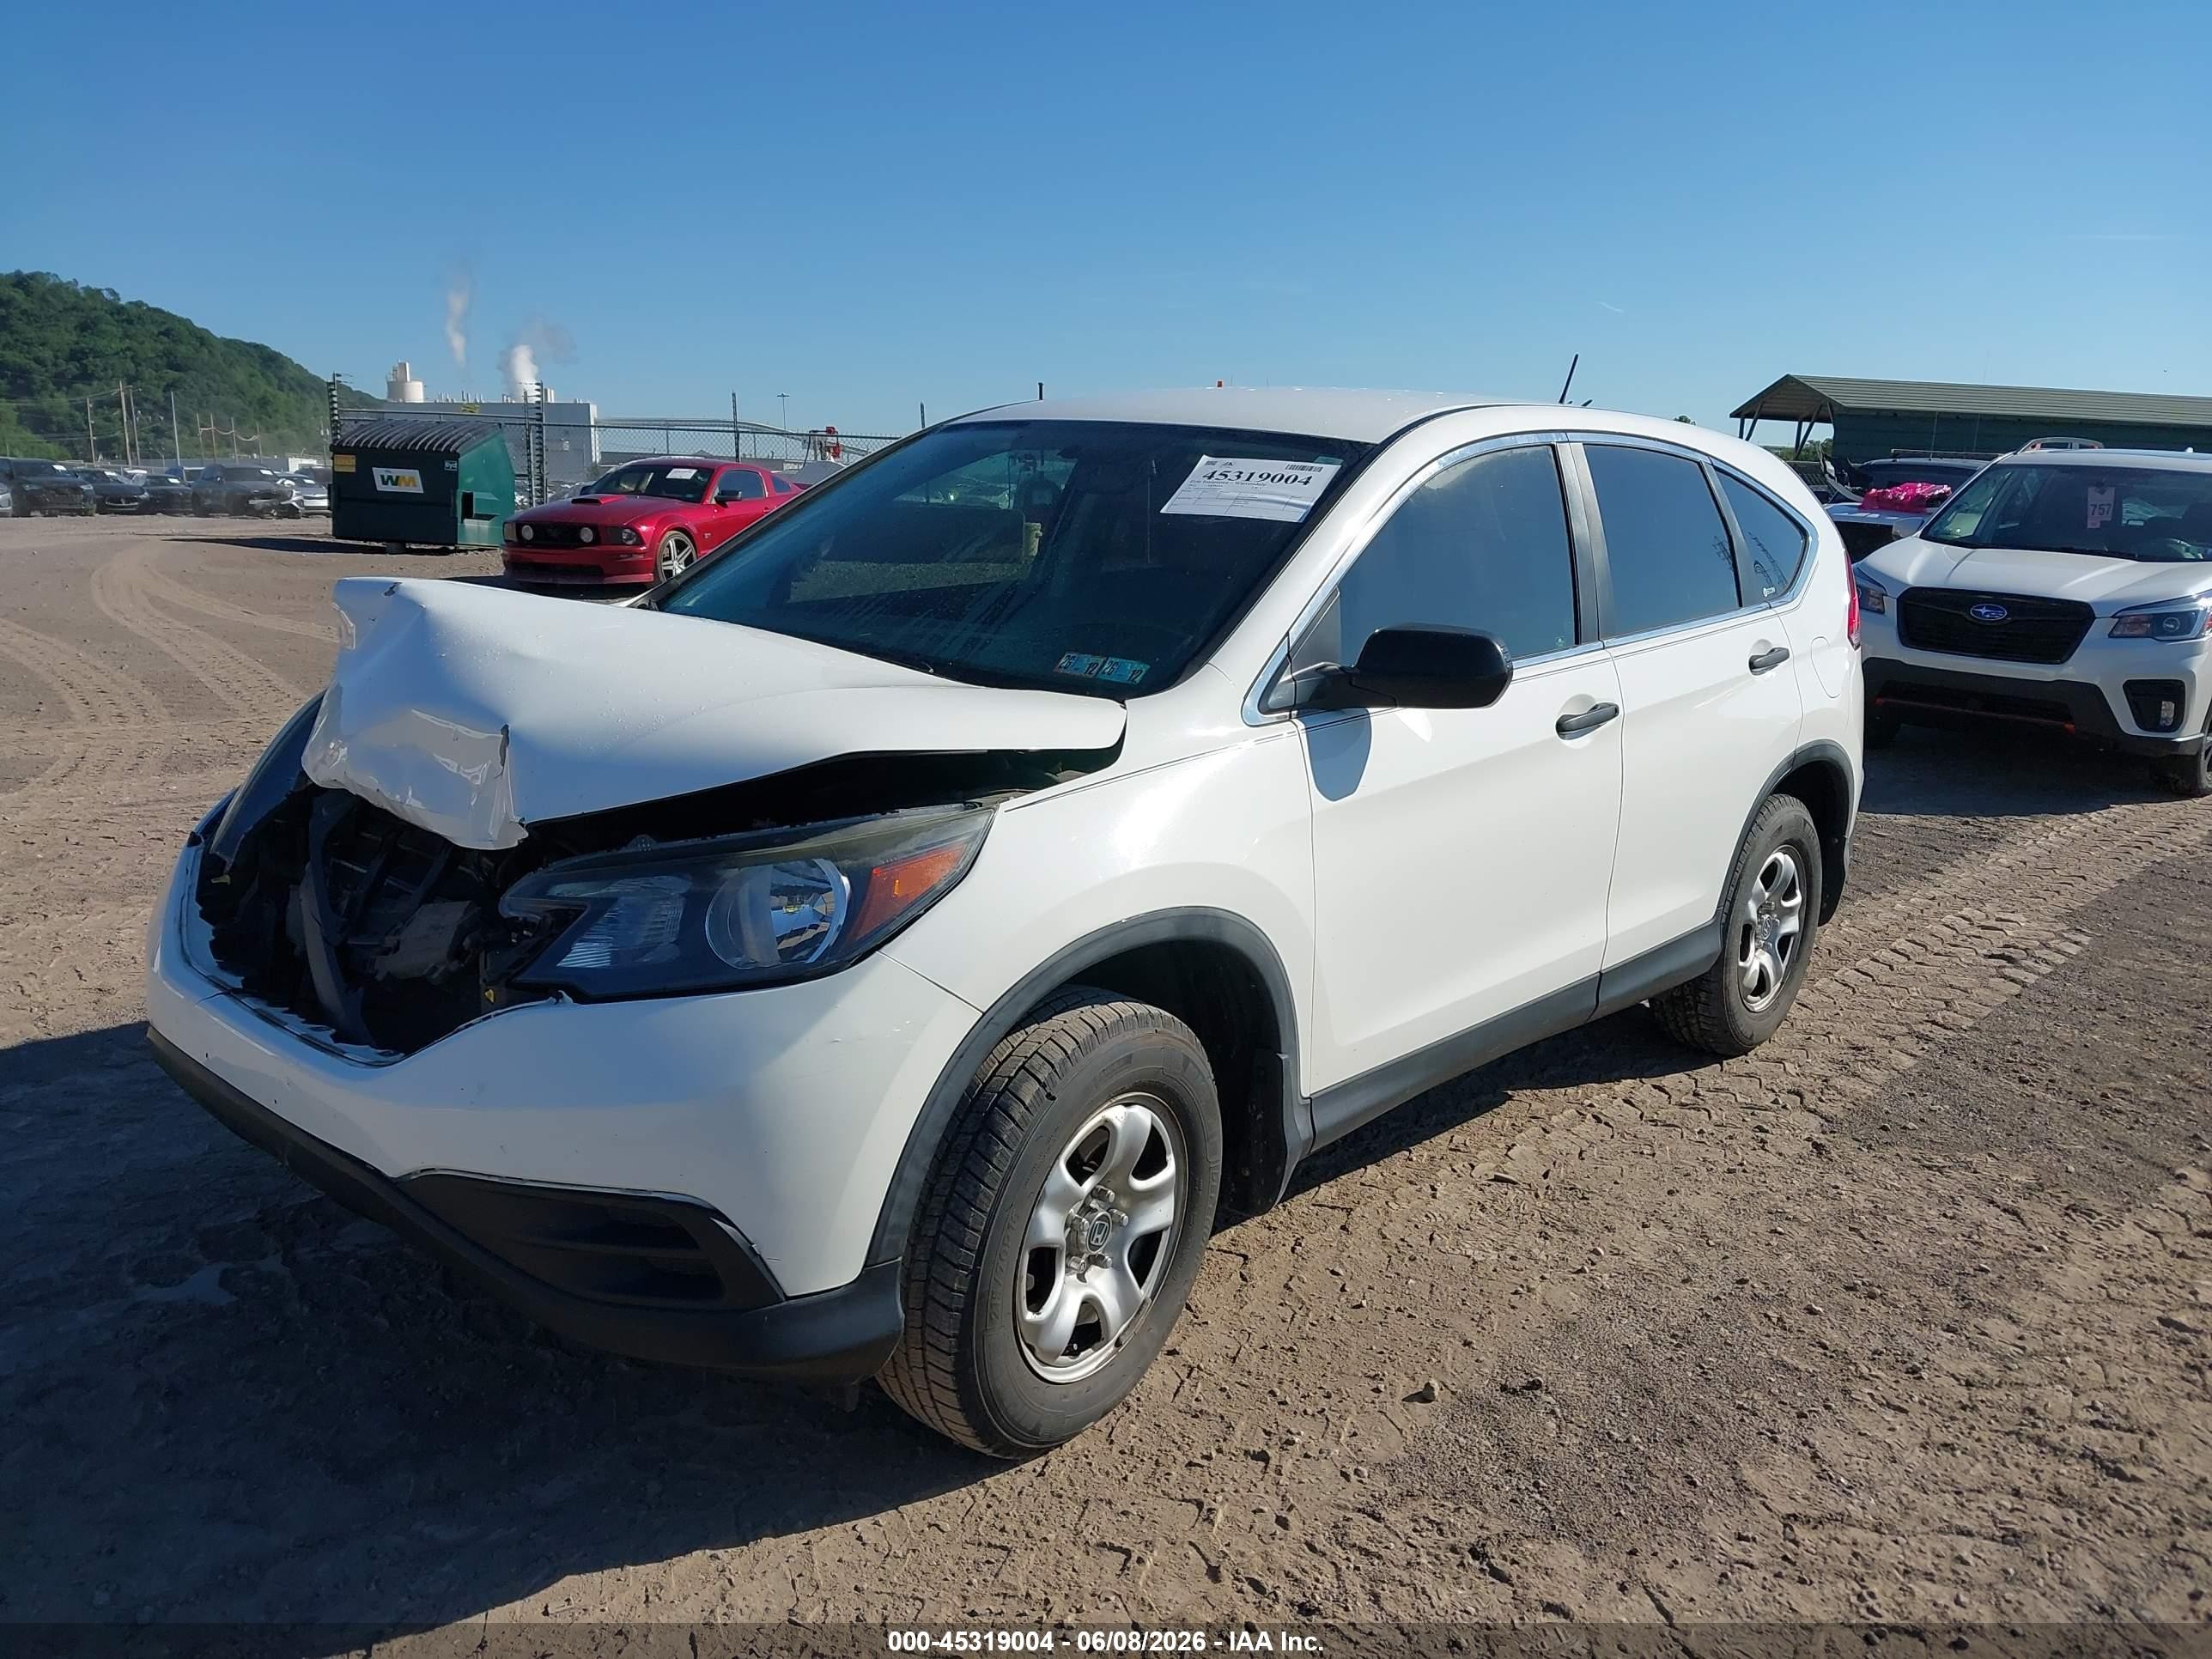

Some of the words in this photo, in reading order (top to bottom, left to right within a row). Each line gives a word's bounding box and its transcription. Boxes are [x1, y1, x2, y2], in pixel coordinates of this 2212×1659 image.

[380, 474, 417, 487] WM
[1202, 470, 1313, 486] 45319004
[2089, 503, 2112, 516] 757
[1085, 662, 1099, 675] 12
[1127, 669, 1144, 681] 12
